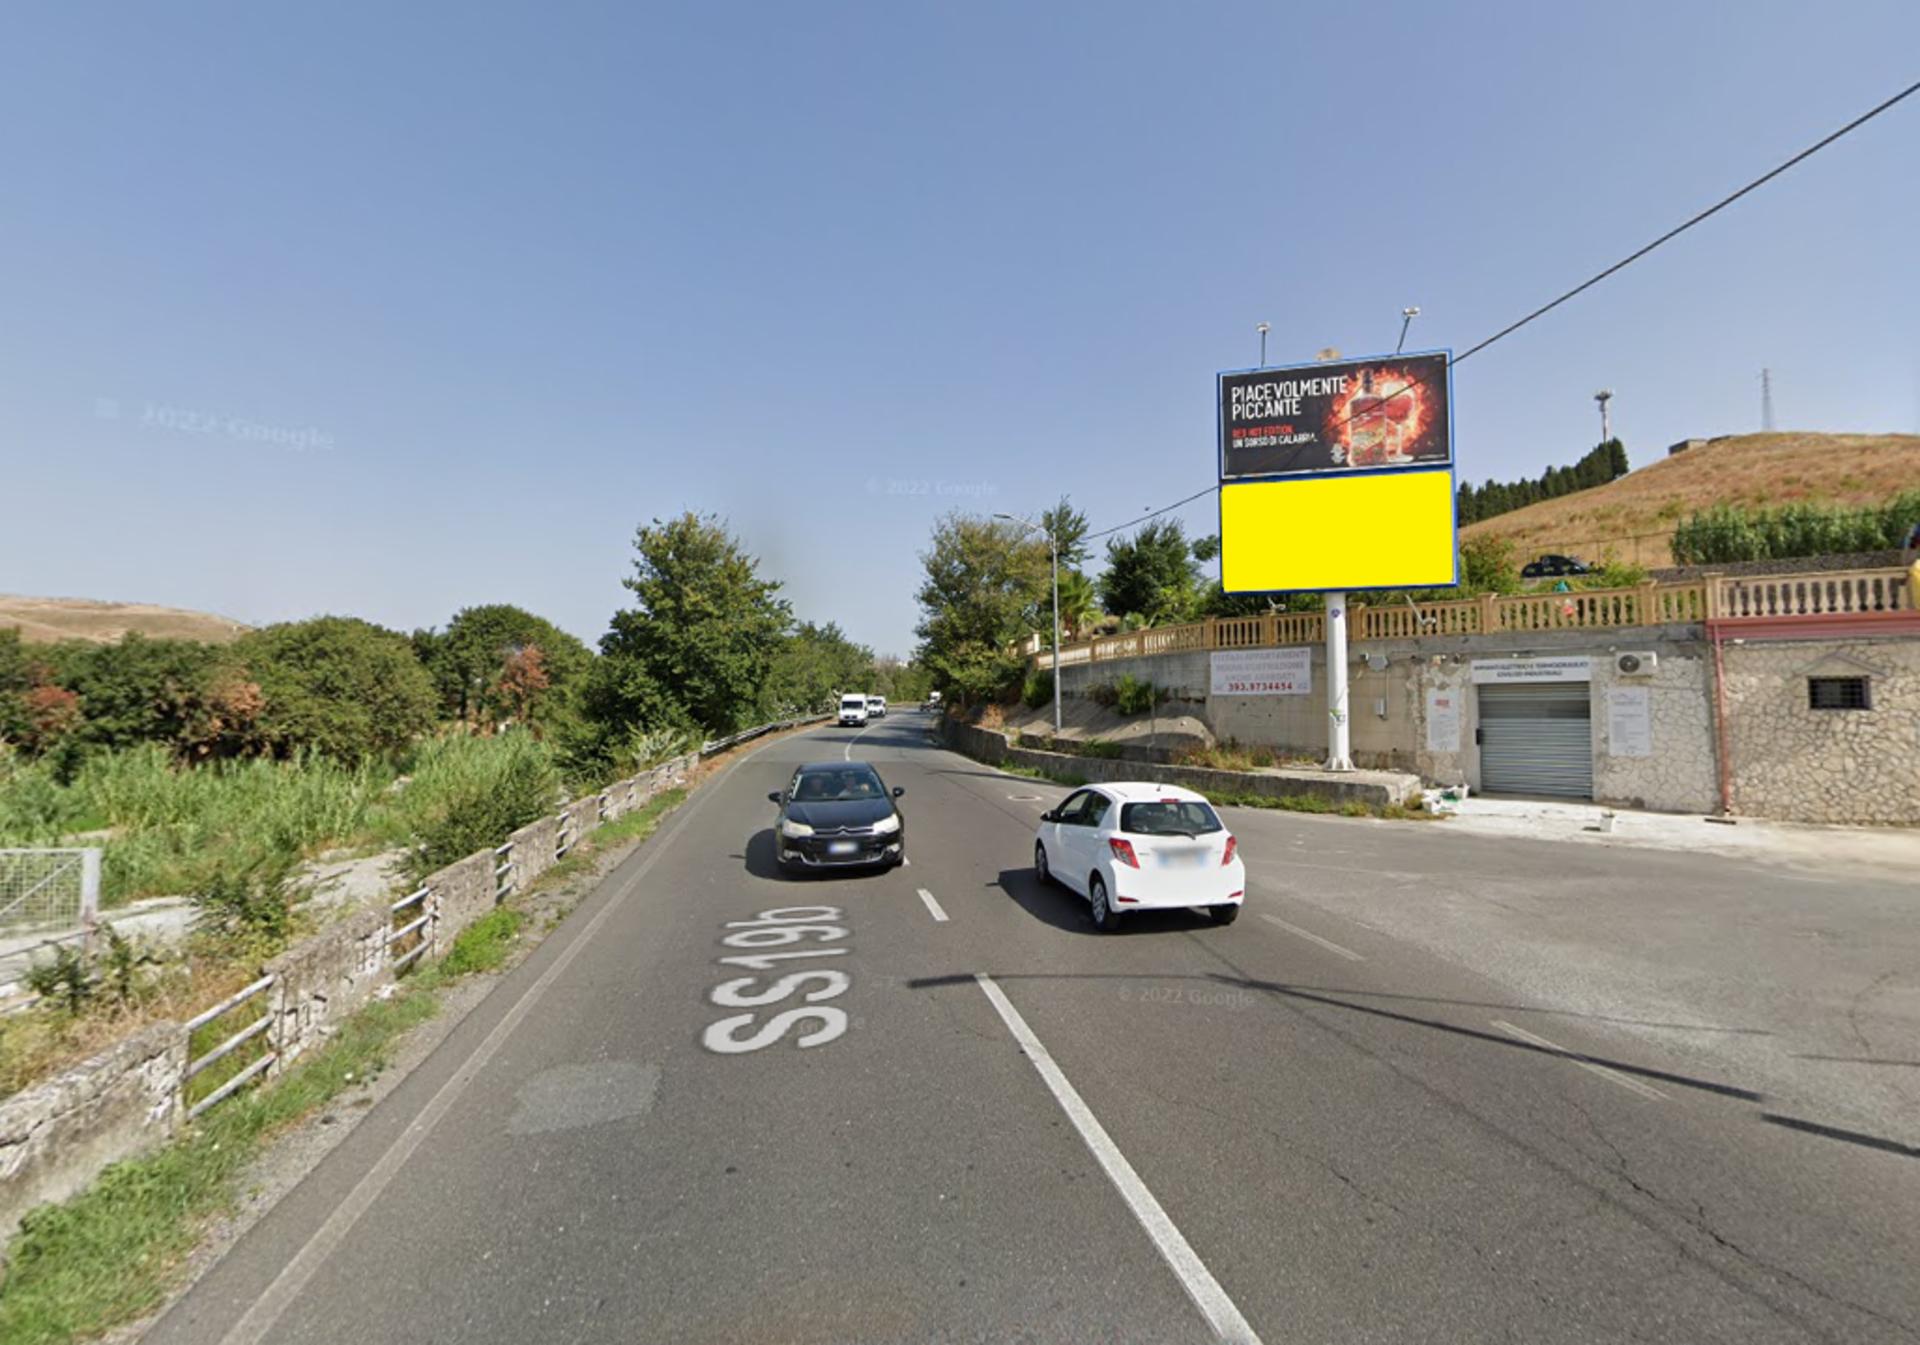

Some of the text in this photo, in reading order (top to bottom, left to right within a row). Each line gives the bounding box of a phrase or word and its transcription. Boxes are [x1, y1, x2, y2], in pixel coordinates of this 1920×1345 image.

[1231, 376, 1349, 403] PIACEVOLMENTE
[1231, 397, 1302, 421] PICCANTE
[1232, 439, 1243, 448] UN
